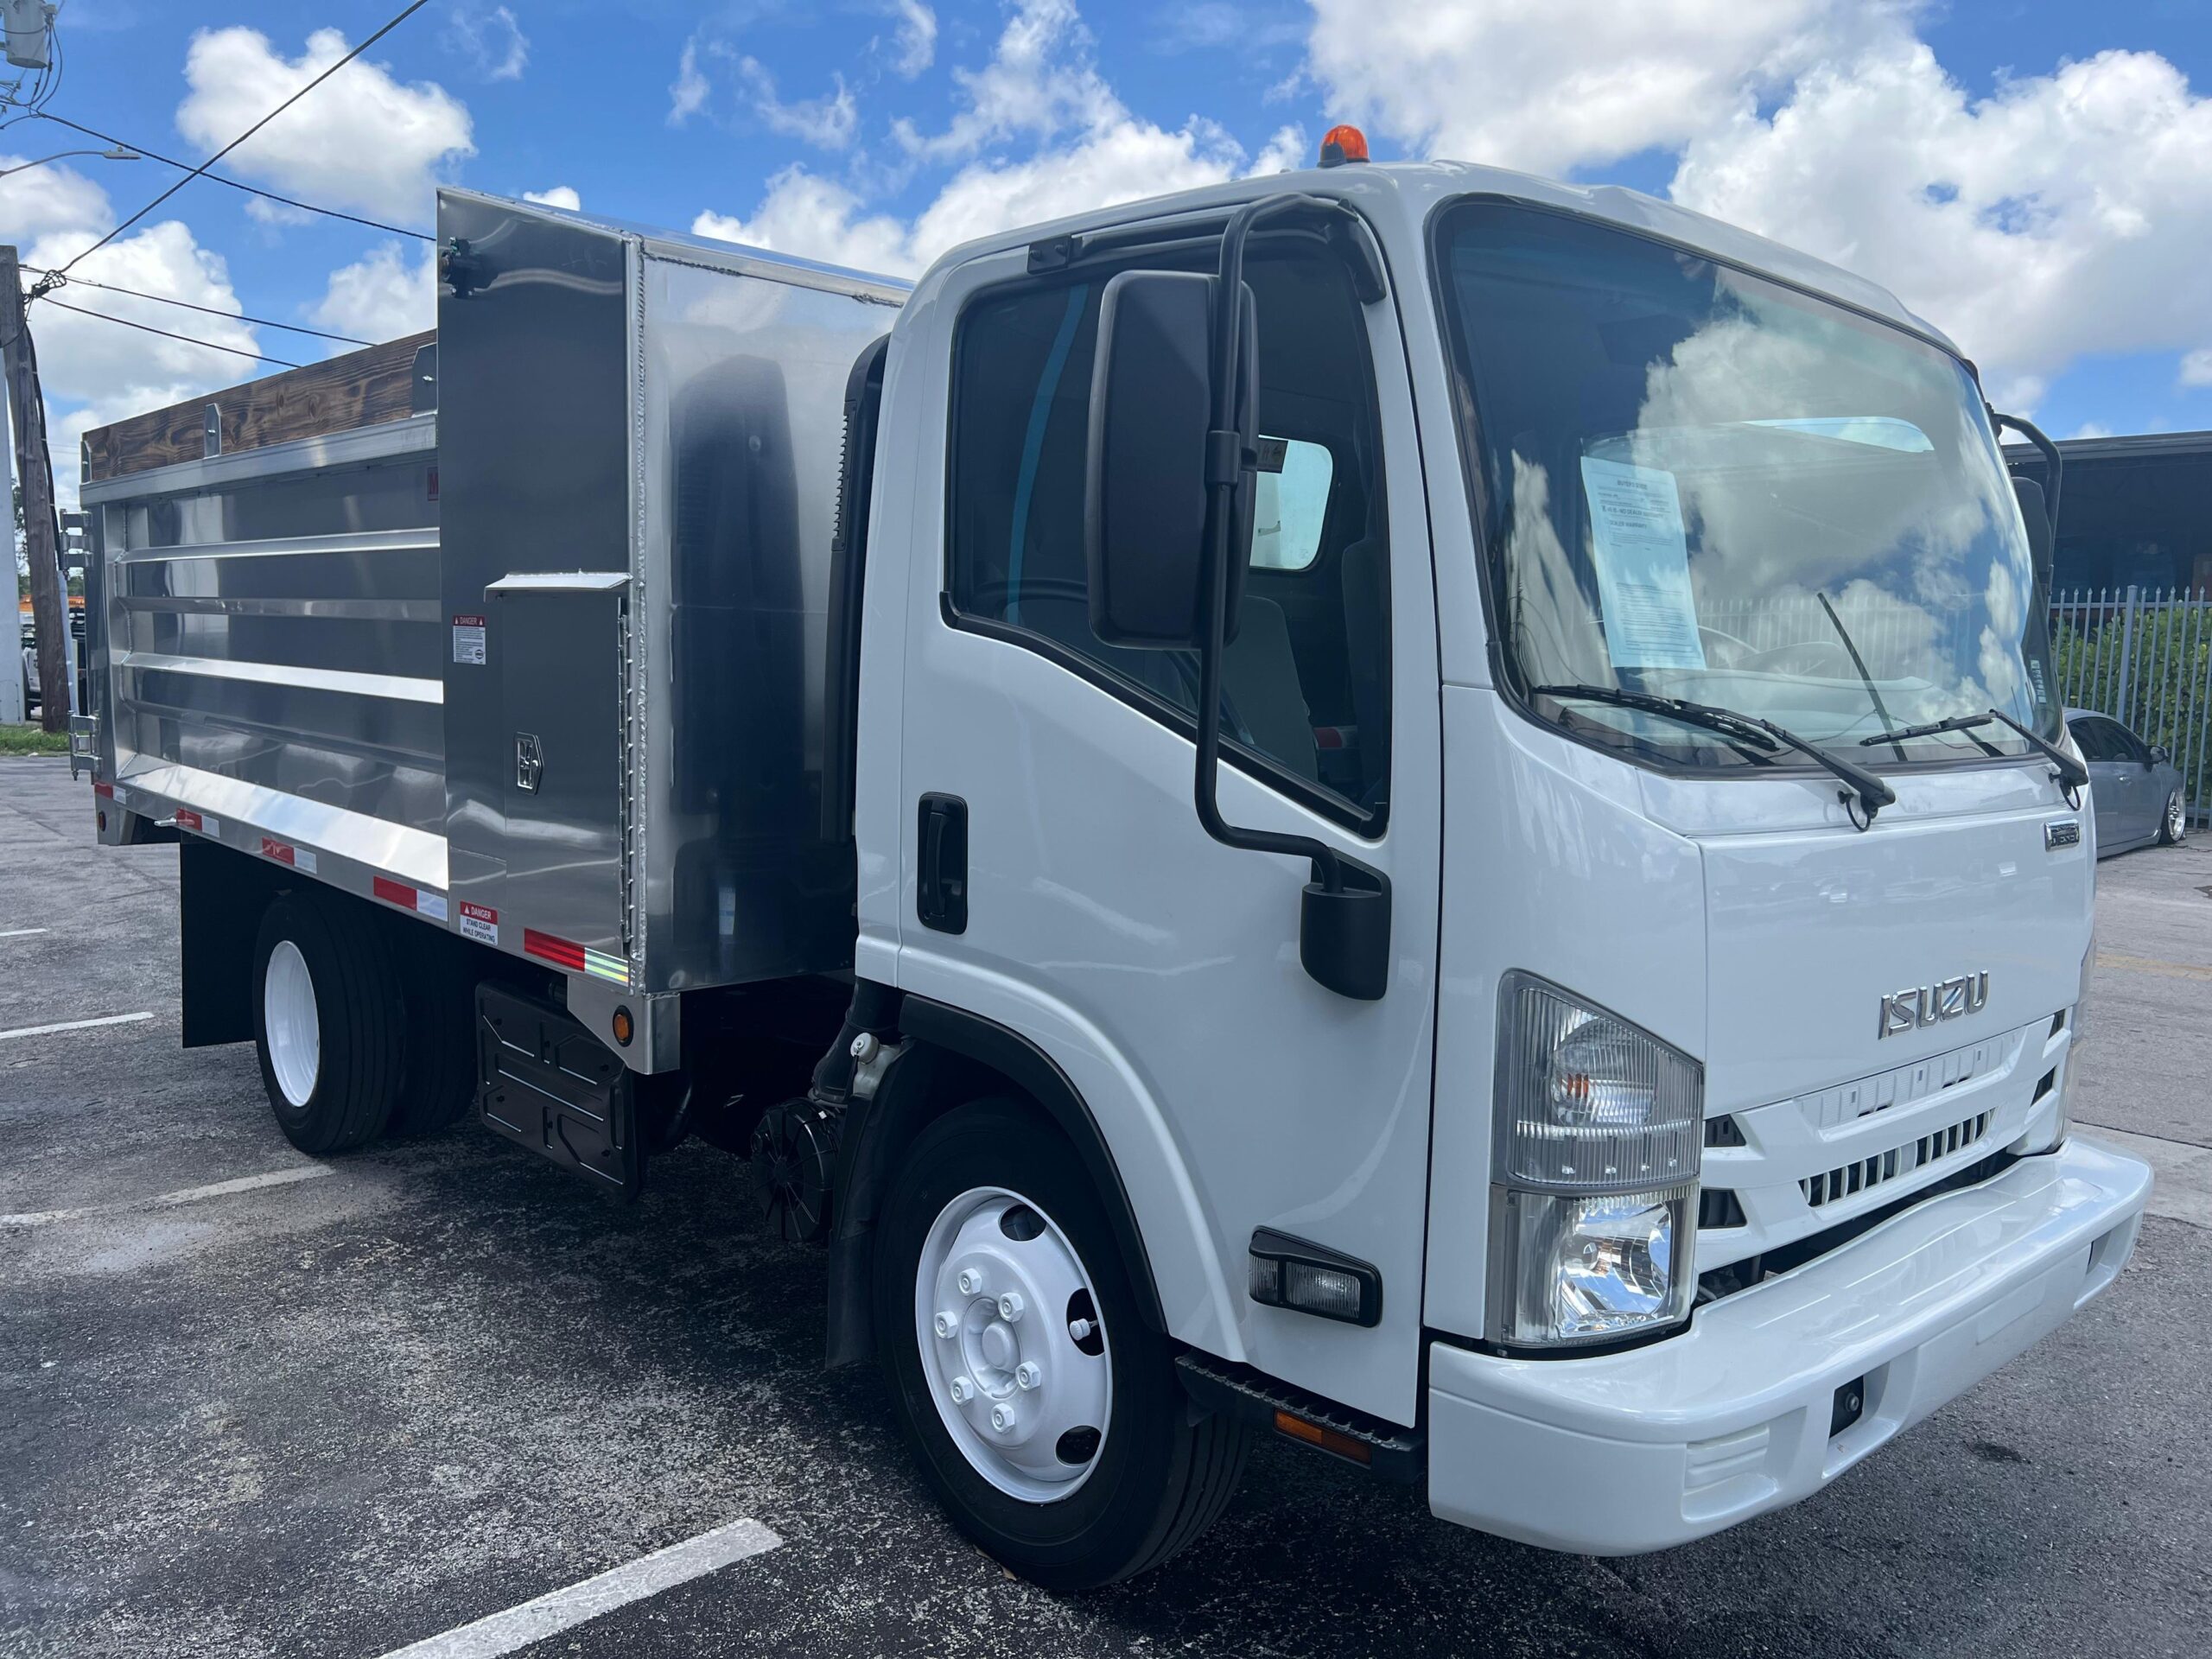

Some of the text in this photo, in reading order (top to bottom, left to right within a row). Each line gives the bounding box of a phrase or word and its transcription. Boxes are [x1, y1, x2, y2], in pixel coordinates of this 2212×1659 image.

[459, 616, 478, 626] DANGER
[471, 906, 492, 920] DANGER
[466, 918, 491, 931] STAND CLEAR
[463, 927, 495, 943] WHILE OPERATING
[1878, 969, 1989, 1040] ISUZU
